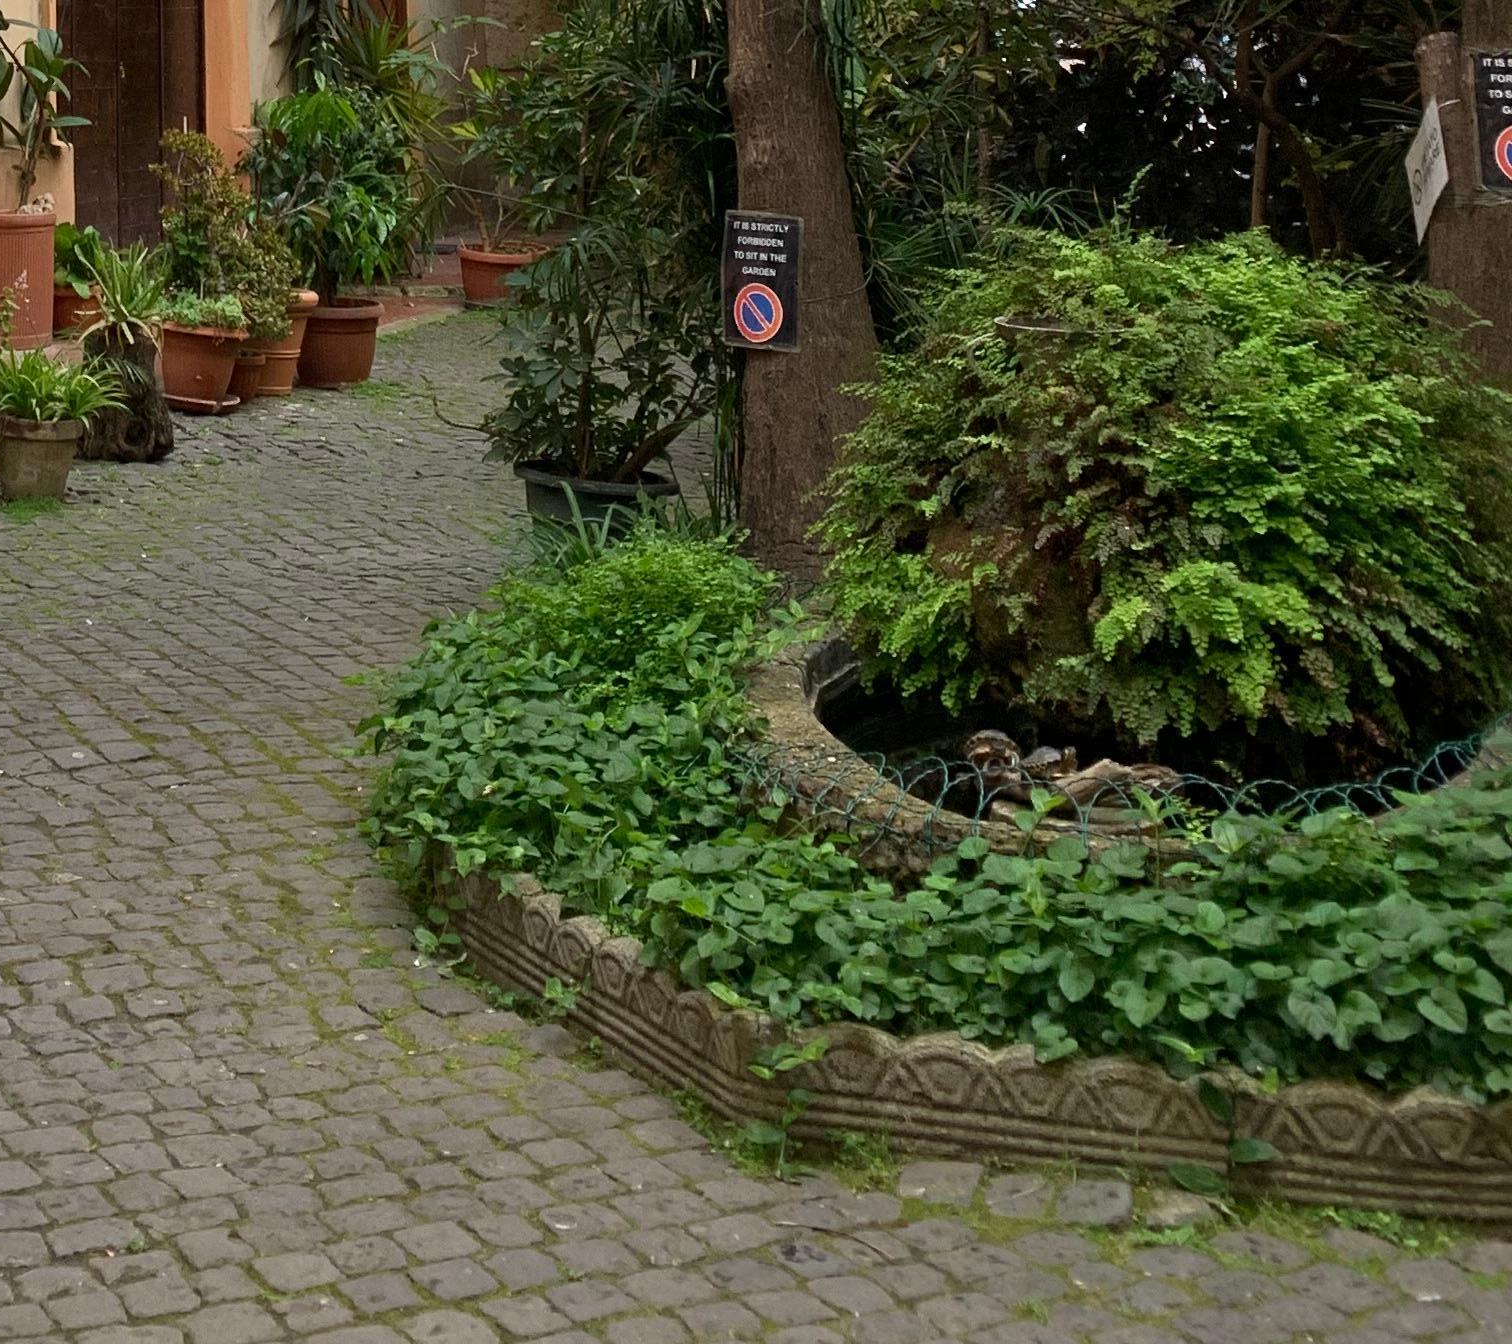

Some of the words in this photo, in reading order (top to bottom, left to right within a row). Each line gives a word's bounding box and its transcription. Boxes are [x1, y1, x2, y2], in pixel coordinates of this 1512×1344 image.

[1483, 58, 1492, 67] IT
[1494, 58, 1506, 68] IS
[1488, 89, 1503, 99] TO
[733, 221, 741, 229] IT
[742, 222, 749, 230] IS
[751, 222, 789, 233] STRICTLY
[737, 236, 784, 247] FORBIDDEN
[734, 251, 745, 259] TO
[746, 251, 758, 260] SIT
[759, 253, 768, 261] IN
[770, 253, 787, 263] THE
[742, 266, 776, 277] GARDEN
